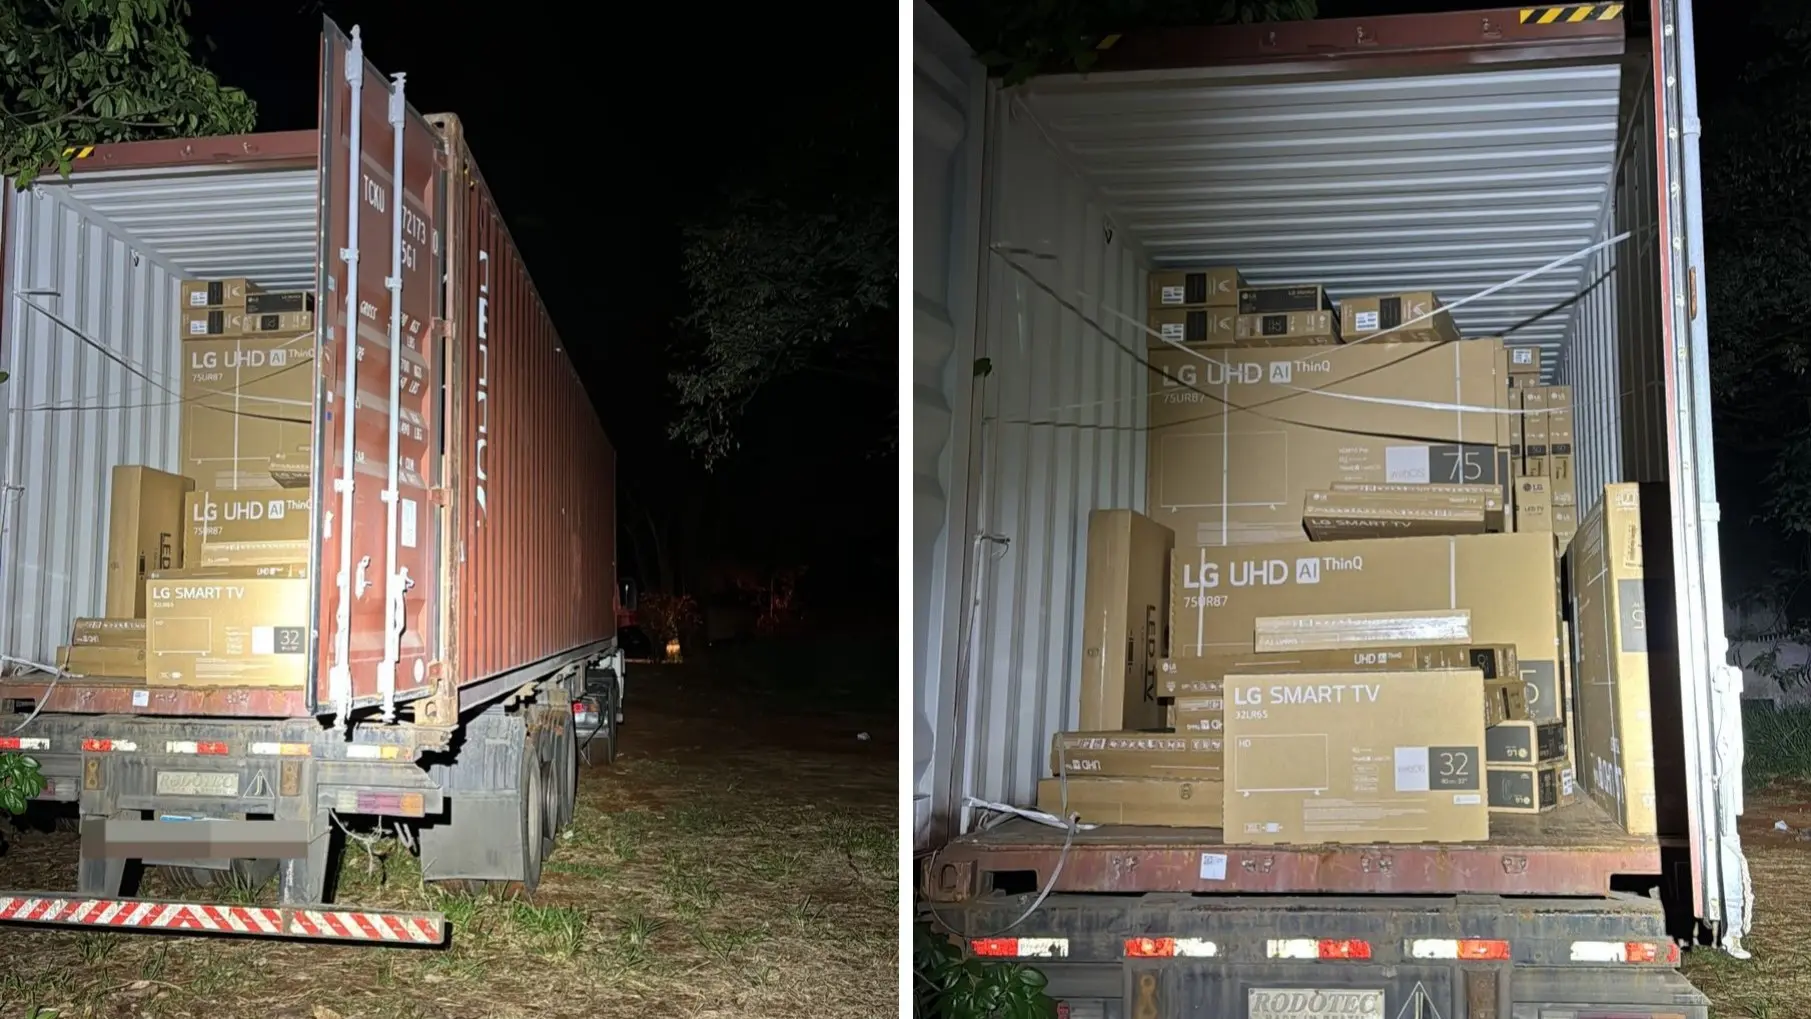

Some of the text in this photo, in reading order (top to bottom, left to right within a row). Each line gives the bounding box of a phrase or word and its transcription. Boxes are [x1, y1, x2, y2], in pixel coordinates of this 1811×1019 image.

[364, 174, 385, 213] TCKU
[191, 351, 217, 369] LG
[224, 350, 266, 368] UHD
[1163, 360, 1331, 387] LG UHD AI ThinQ
[1442, 452, 1482, 480] 75
[193, 502, 218, 521] LG
[223, 501, 264, 520] UHD
[269, 503, 283, 518] AI
[1311, 518, 1412, 528] LG SMART TV
[1183, 556, 1363, 588] LG UHD AI ThinQ
[152, 586, 244, 599] LG SMART TV
[280, 629, 300, 645] 32
[1147, 604, 1156, 659] LED
[1354, 654, 1376, 665] UHD
[1234, 683, 1380, 705] LG SMART TV
[1238, 739, 1251, 748] HD
[1439, 752, 1469, 776] 32
[1252, 992, 1378, 1013] RODOTEC
